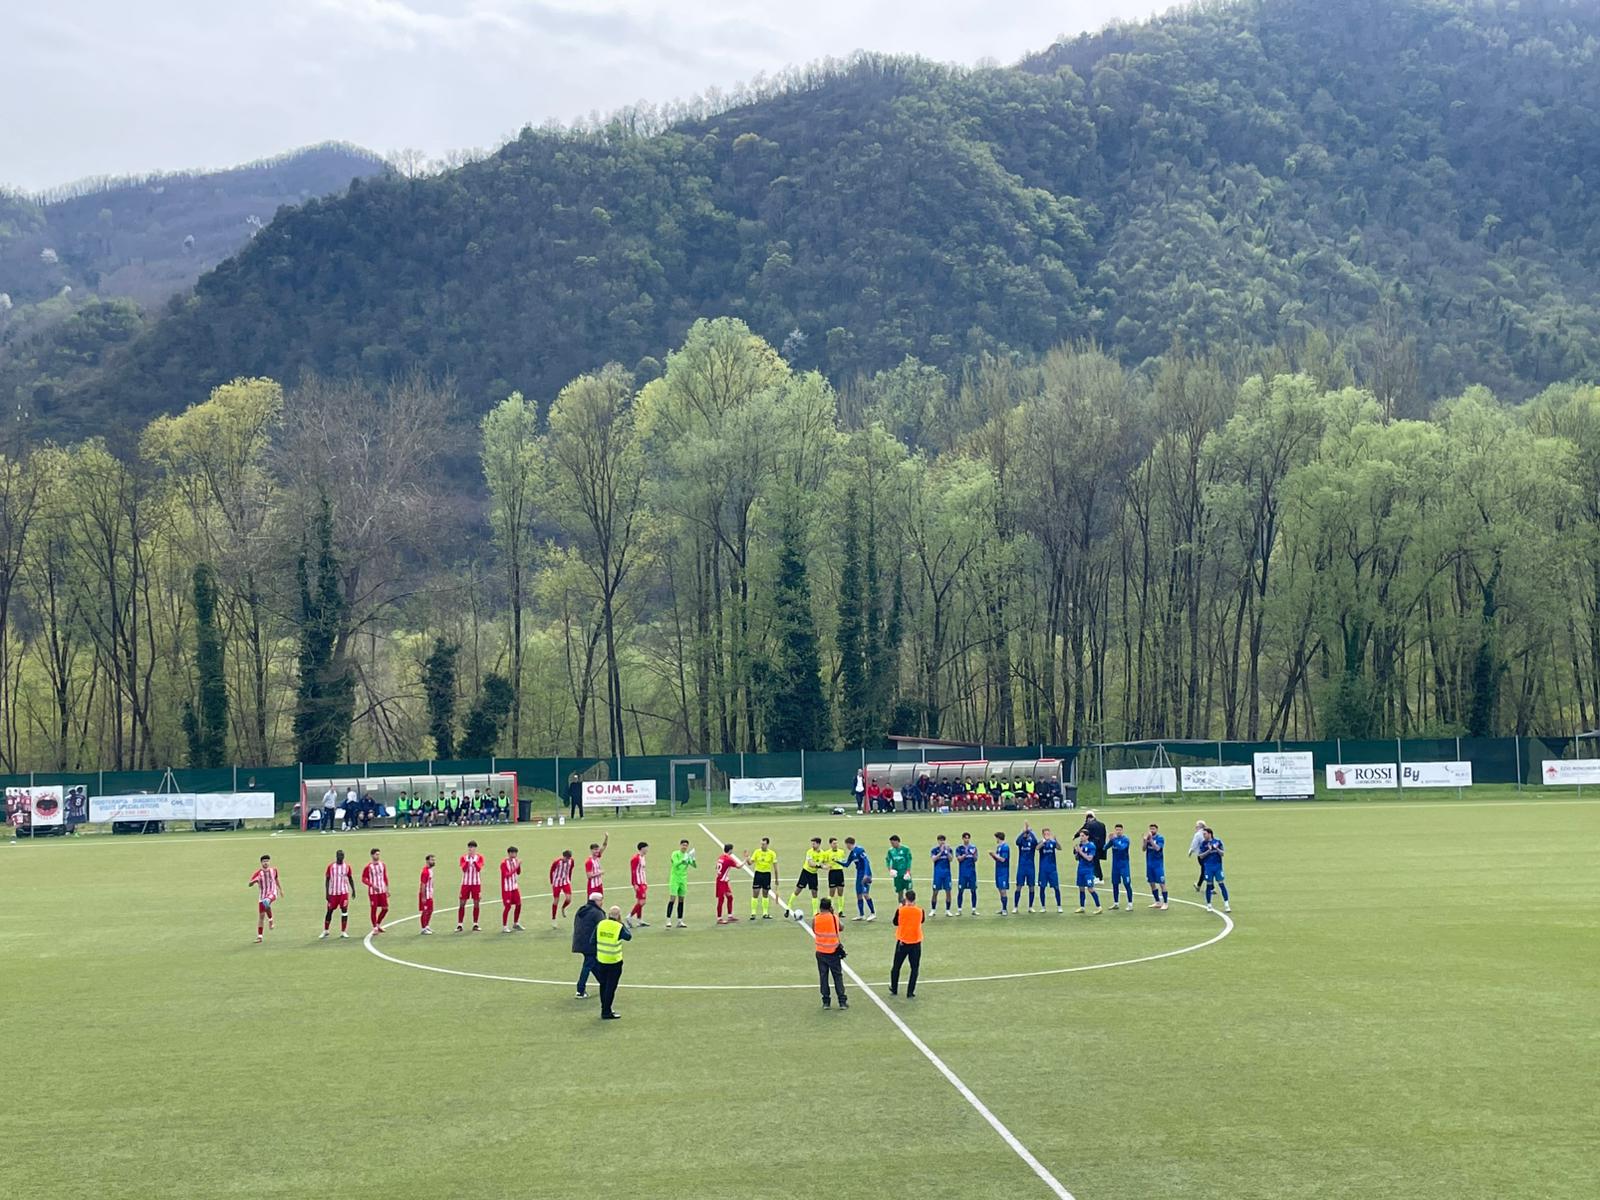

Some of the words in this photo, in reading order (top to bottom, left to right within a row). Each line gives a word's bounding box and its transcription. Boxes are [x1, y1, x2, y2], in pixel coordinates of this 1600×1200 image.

[1355, 767, 1393, 780] ROSSI
[1403, 767, 1420, 782] By
[586, 783, 638, 795] CO.IM.E.
[754, 781, 776, 791] SILVA
